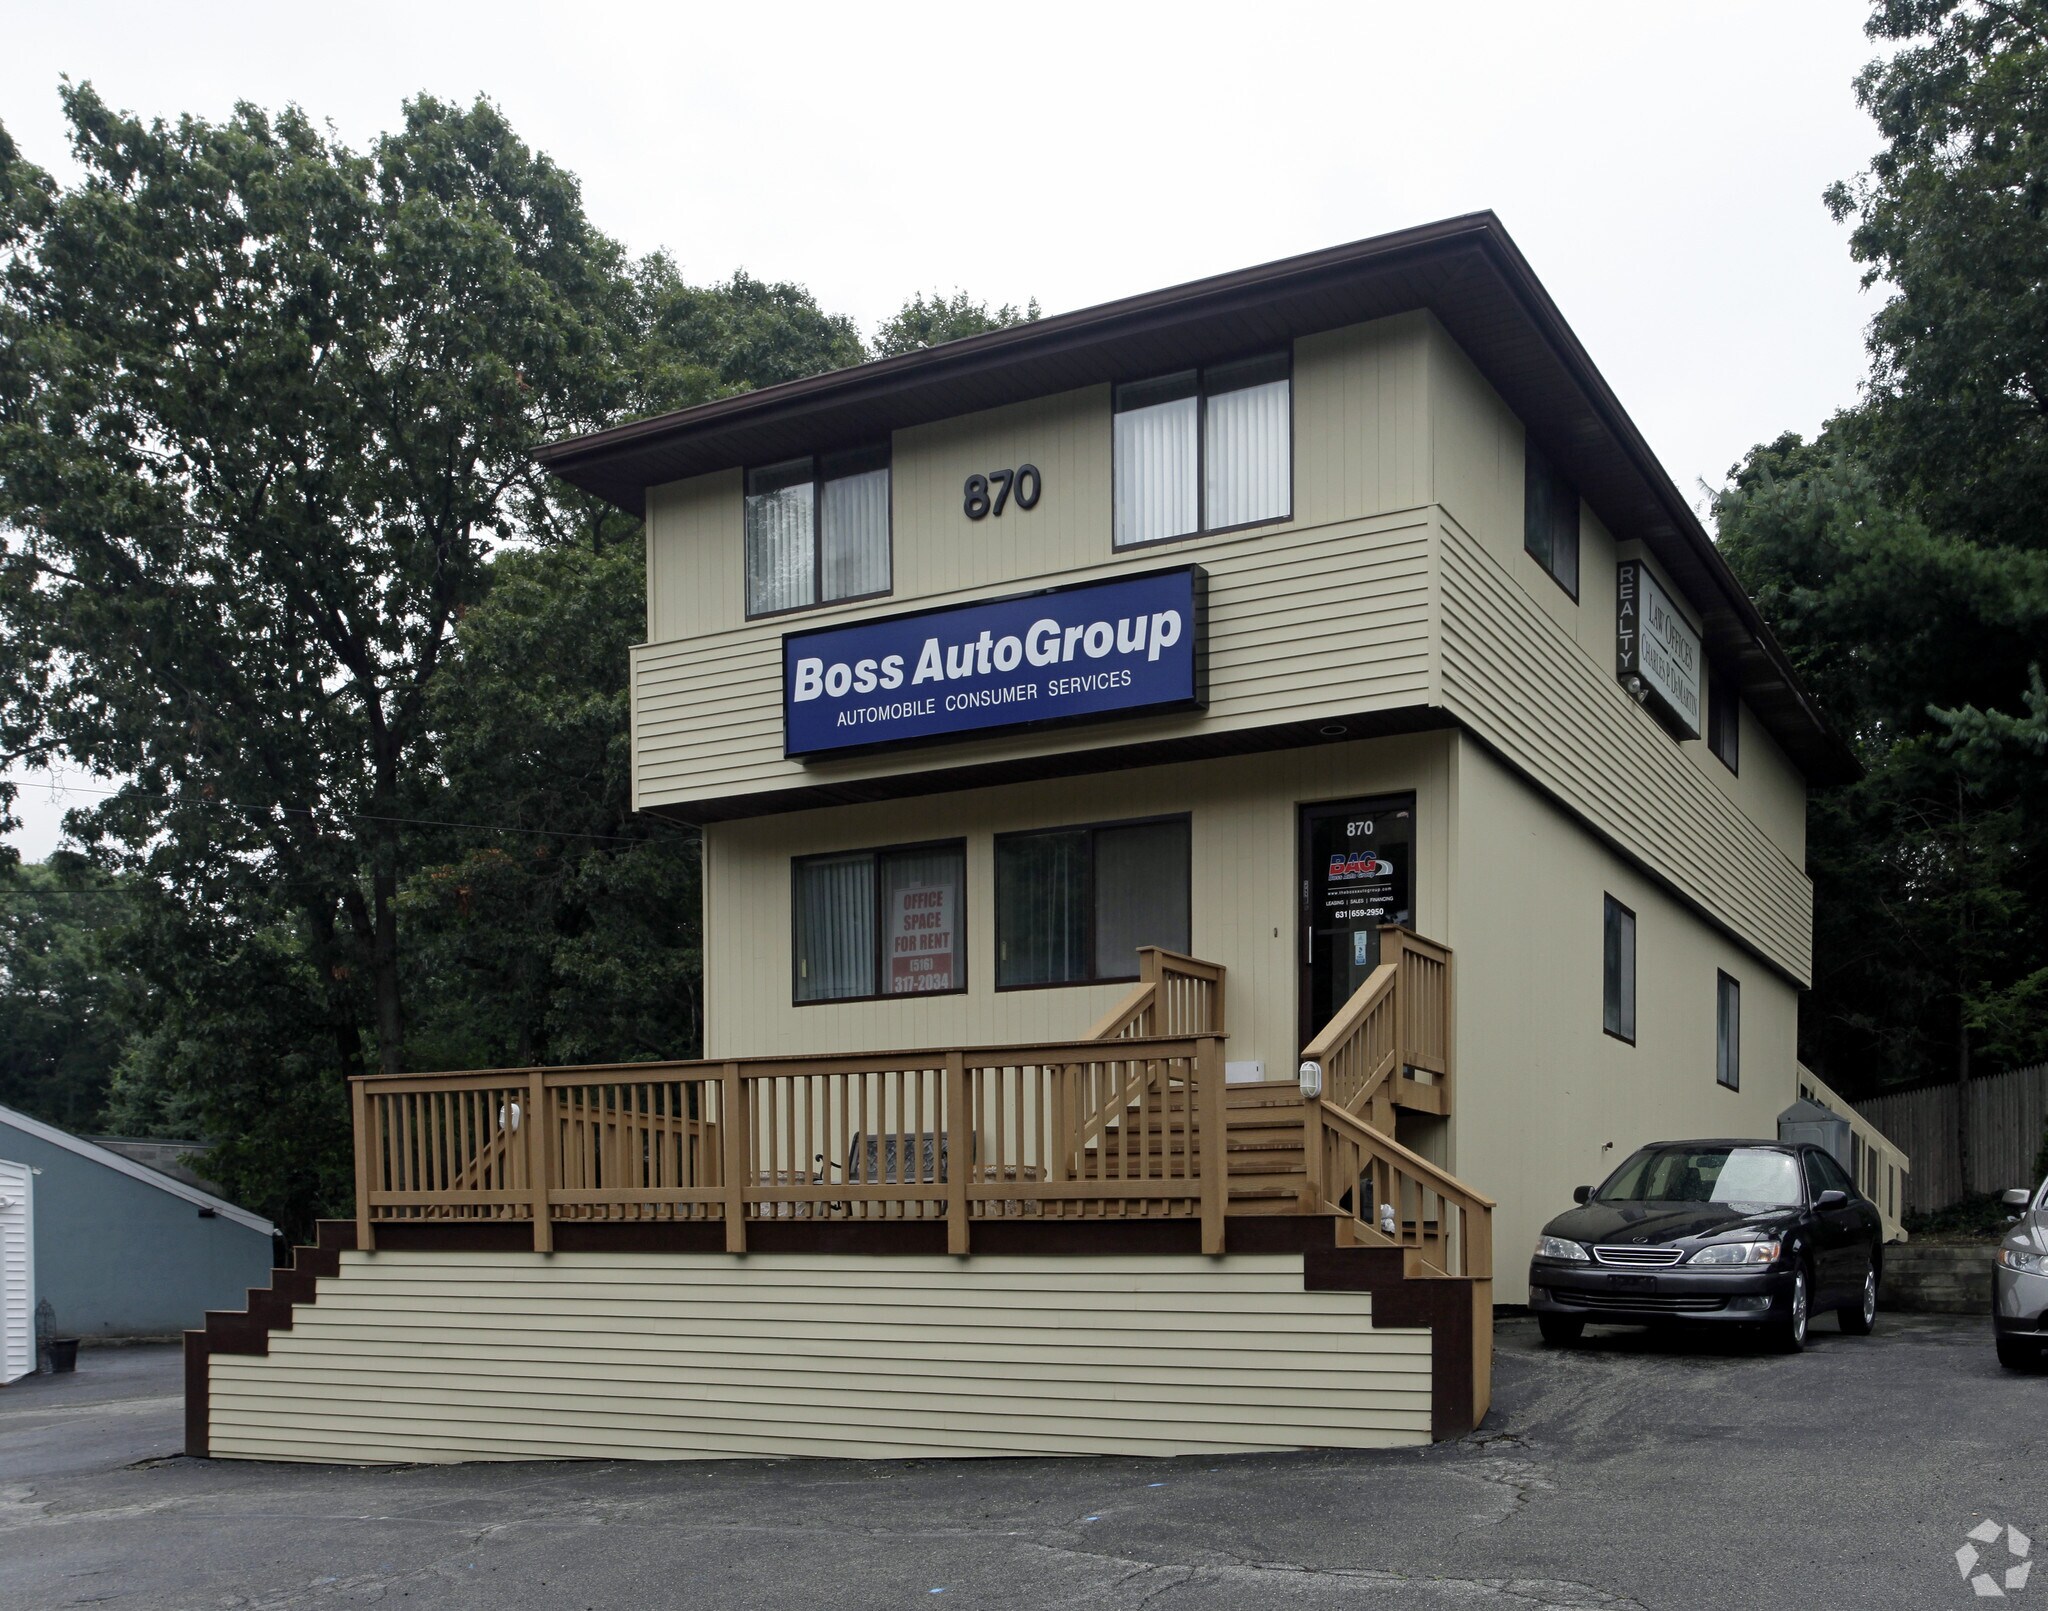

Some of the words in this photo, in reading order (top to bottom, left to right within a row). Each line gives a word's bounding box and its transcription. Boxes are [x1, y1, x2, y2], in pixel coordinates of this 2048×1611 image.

[964, 464, 1041, 520] 870
[1619, 566, 1634, 668] REALTY
[794, 654, 905, 702] Boss
[911, 609, 1182, 686] AutoGroup
[837, 698, 936, 727] AUTOMOBILE
[945, 683, 1038, 712] CONSUMER
[1048, 669, 1132, 697] SERVICES
[1346, 820, 1374, 837] 870
[1329, 850, 1377, 875] BAG
[903, 891, 943, 910] OFFICE
[903, 911, 942, 931] SPACE
[894, 935, 917, 953] FOR
[919, 931, 950, 950] RENT
[910, 957, 933, 972] (516)
[895, 973, 948, 992] 317-2034
